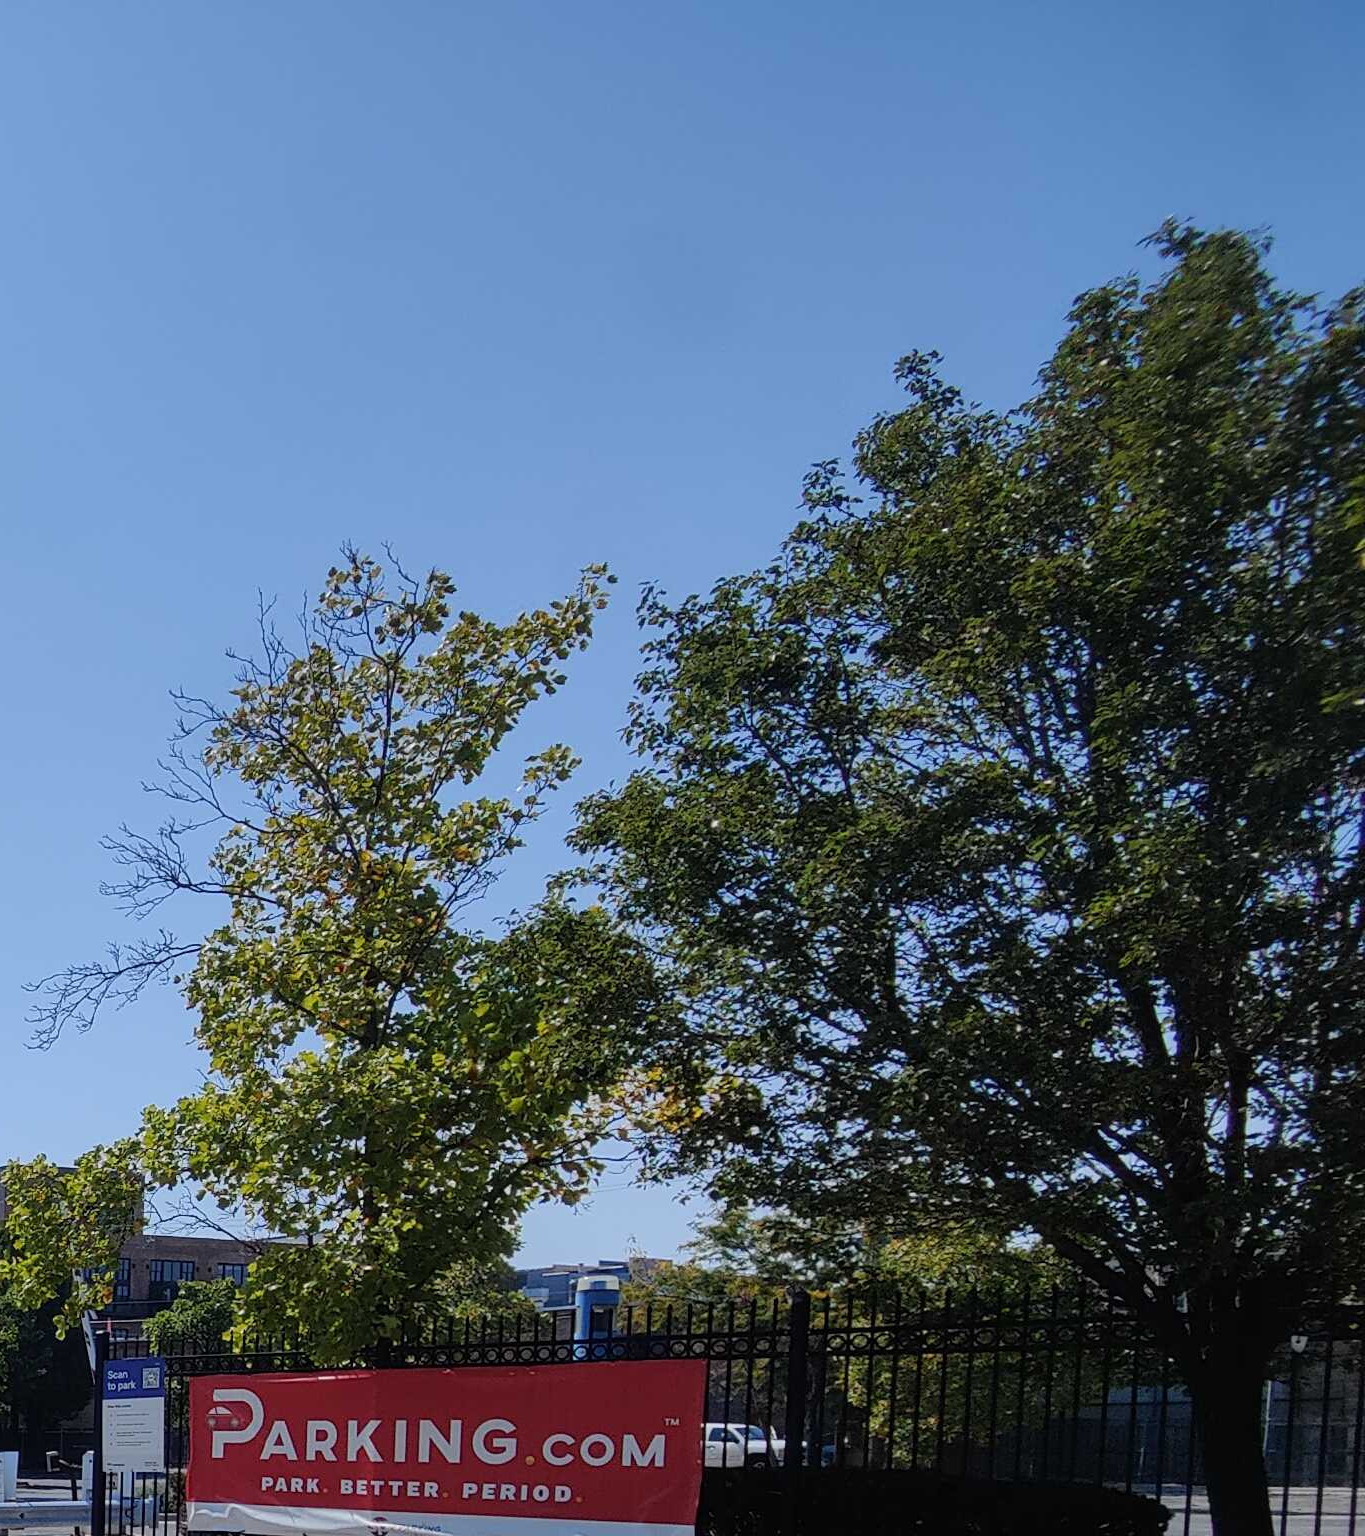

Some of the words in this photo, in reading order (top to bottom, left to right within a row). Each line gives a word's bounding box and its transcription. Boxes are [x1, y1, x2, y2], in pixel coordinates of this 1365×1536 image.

[108, 1371, 128, 1380] Scan
[108, 1382, 116, 1390] to
[118, 1381, 136, 1392] park
